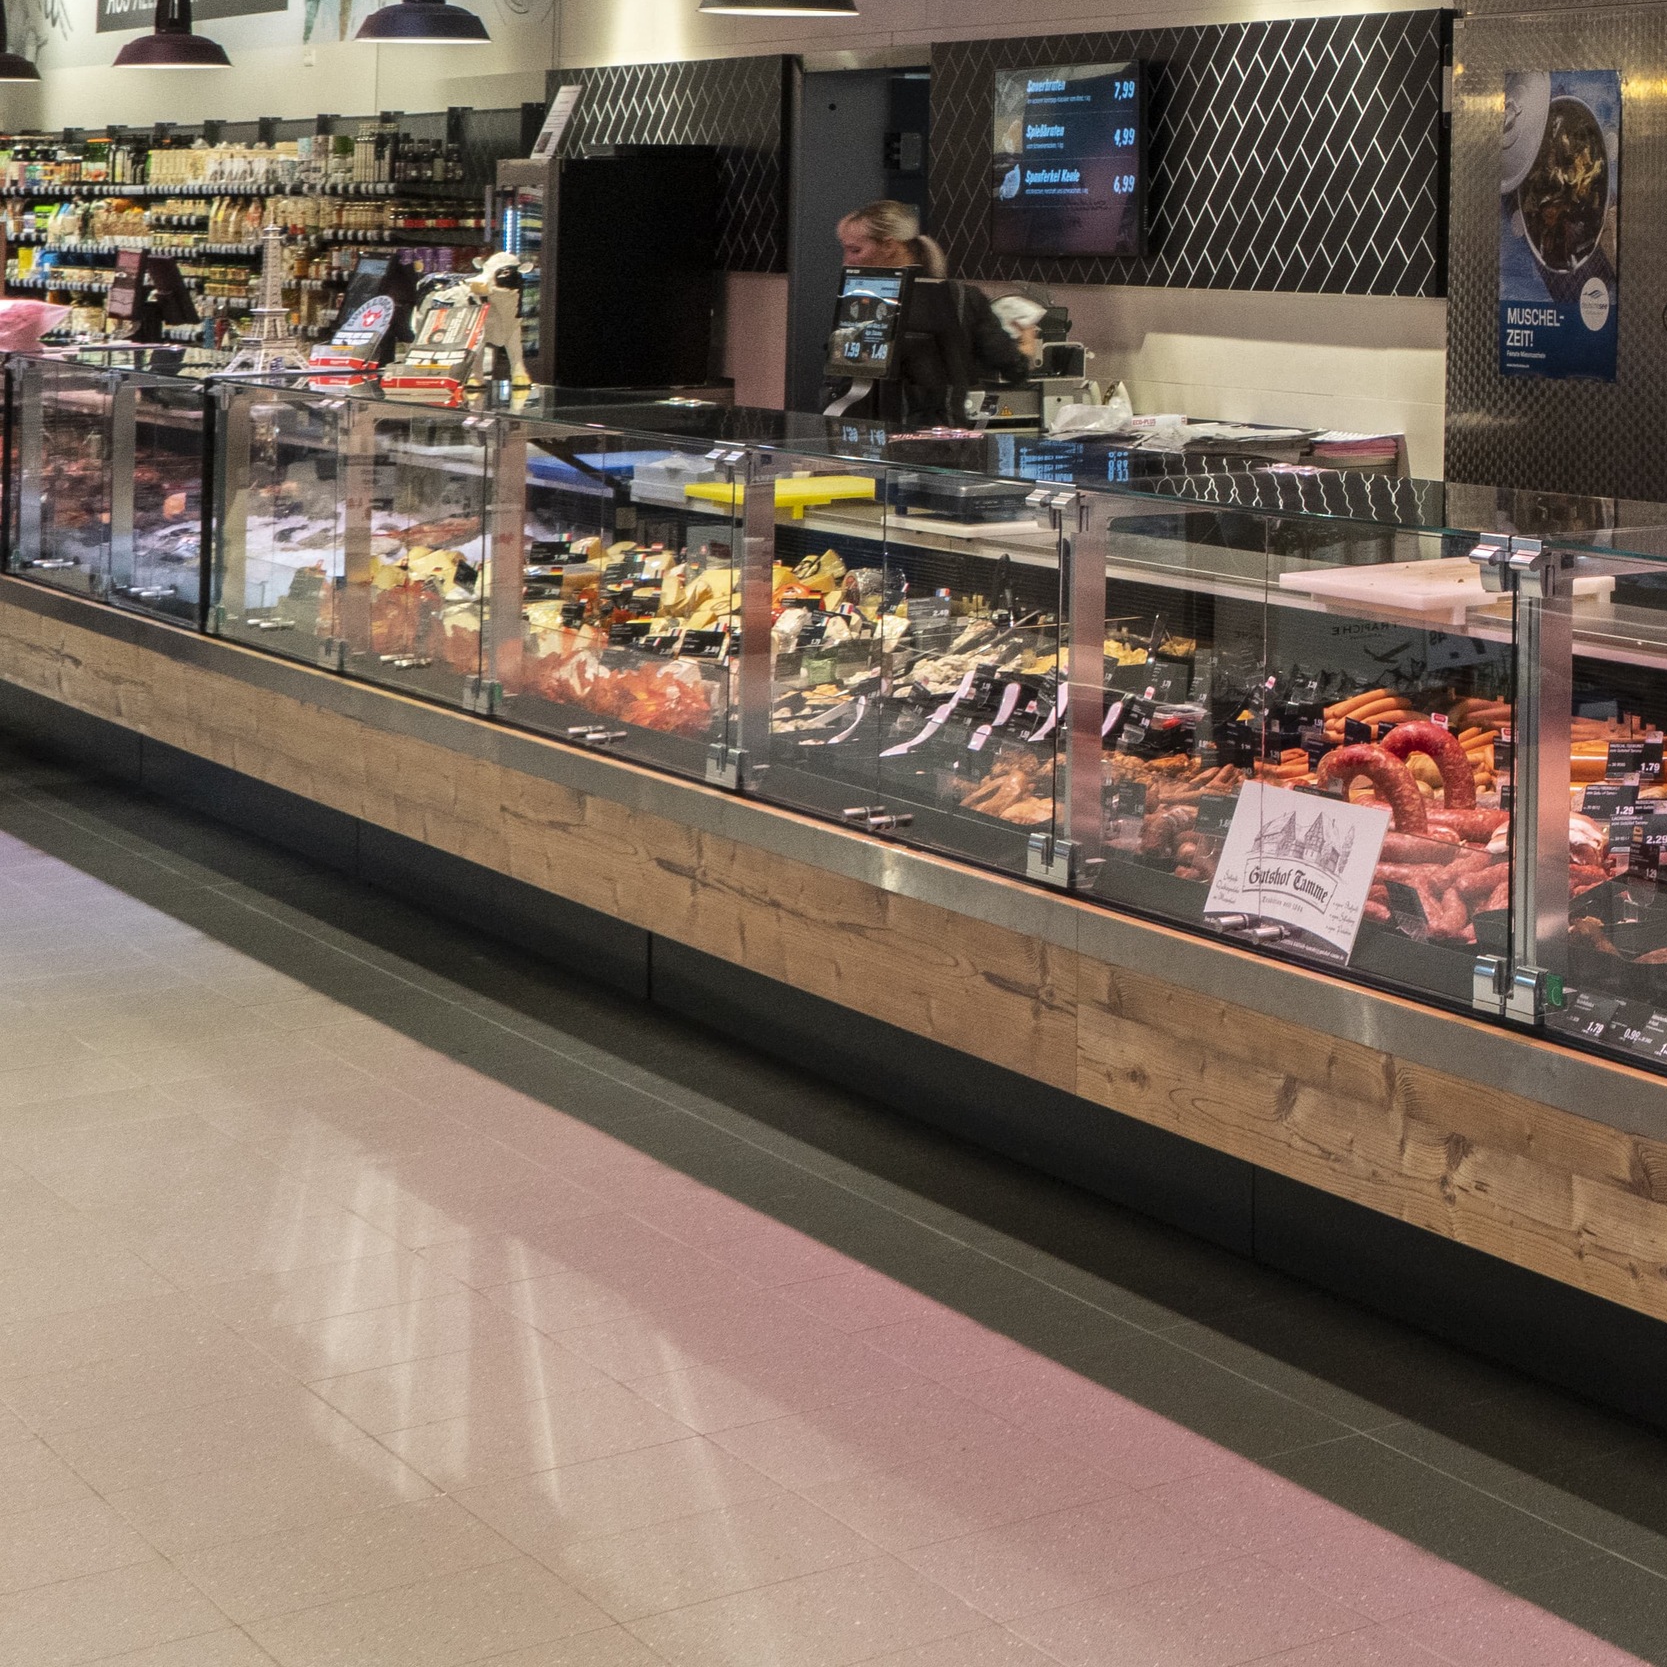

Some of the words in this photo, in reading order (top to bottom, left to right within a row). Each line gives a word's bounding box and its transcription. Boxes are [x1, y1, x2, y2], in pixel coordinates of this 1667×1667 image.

[1114, 81, 1134, 100] 7,99
[1114, 128, 1135, 147] 4,99
[1113, 175, 1135, 194] 6,99
[1507, 308, 1564, 327] MUSCHEL-
[1506, 329, 1533, 347] ZEIT!
[1640, 762, 1661, 772] 1.79
[1615, 806, 1634, 815] 1.29
[1249, 866, 1293, 886] Gutshof
[1293, 869, 1329, 904] Tamme
[1586, 1021, 1605, 1034] 1.79
